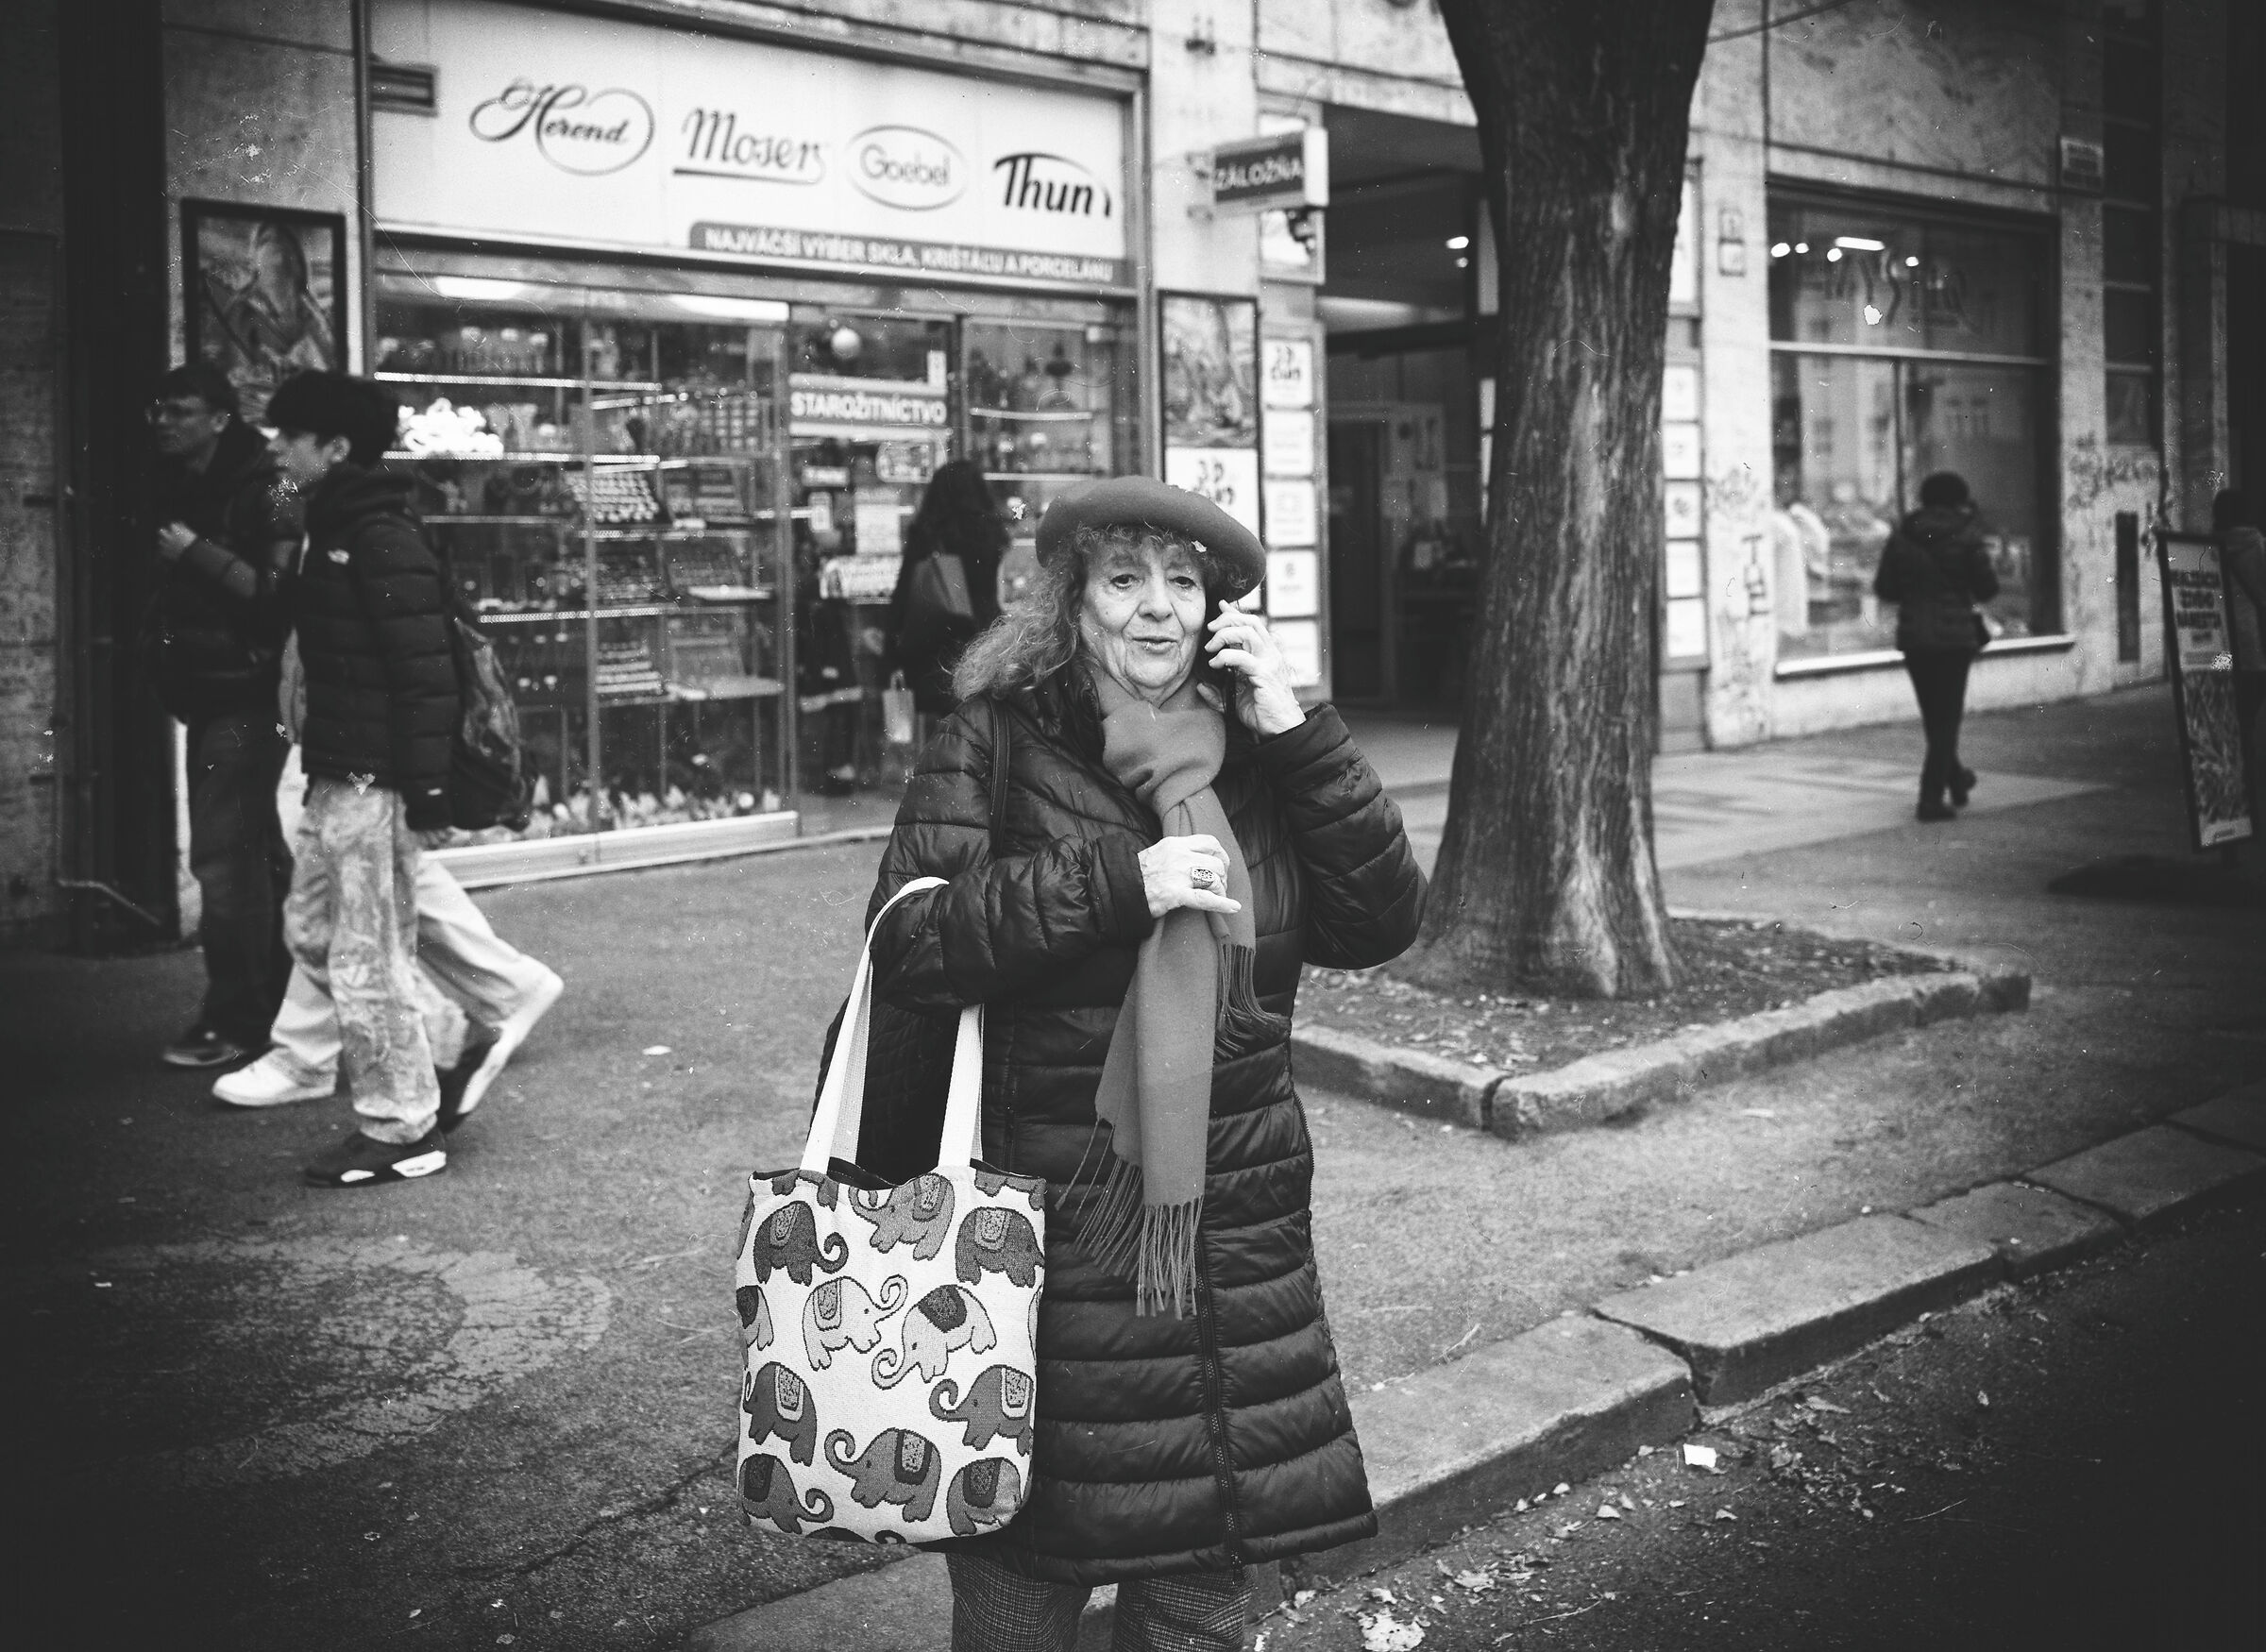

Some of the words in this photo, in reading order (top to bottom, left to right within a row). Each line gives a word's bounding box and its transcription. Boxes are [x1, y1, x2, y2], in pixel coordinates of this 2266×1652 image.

[469, 78, 654, 176] Herend
[677, 107, 827, 179] Moser
[859, 143, 952, 188] Goebel
[994, 152, 1110, 217] Thun
